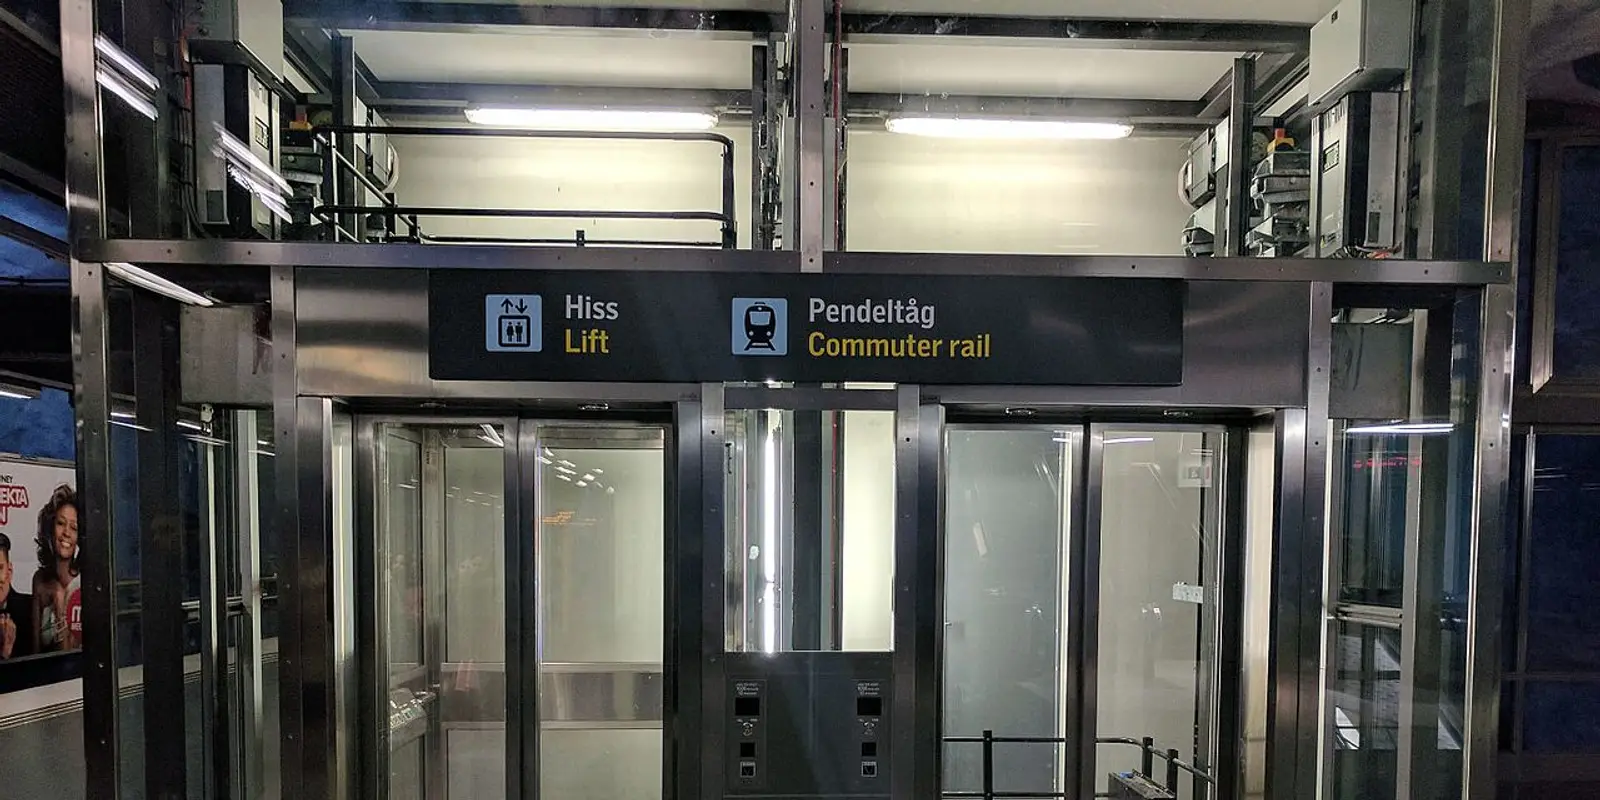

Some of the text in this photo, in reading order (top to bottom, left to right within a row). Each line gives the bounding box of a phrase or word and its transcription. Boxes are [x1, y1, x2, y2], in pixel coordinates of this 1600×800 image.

[565, 294, 619, 320] Hiss
[809, 298, 935, 329] Pendeltåg
[565, 328, 609, 353] Lift
[808, 331, 990, 357] Commuter rail
[0, 475, 13, 483] NEY
